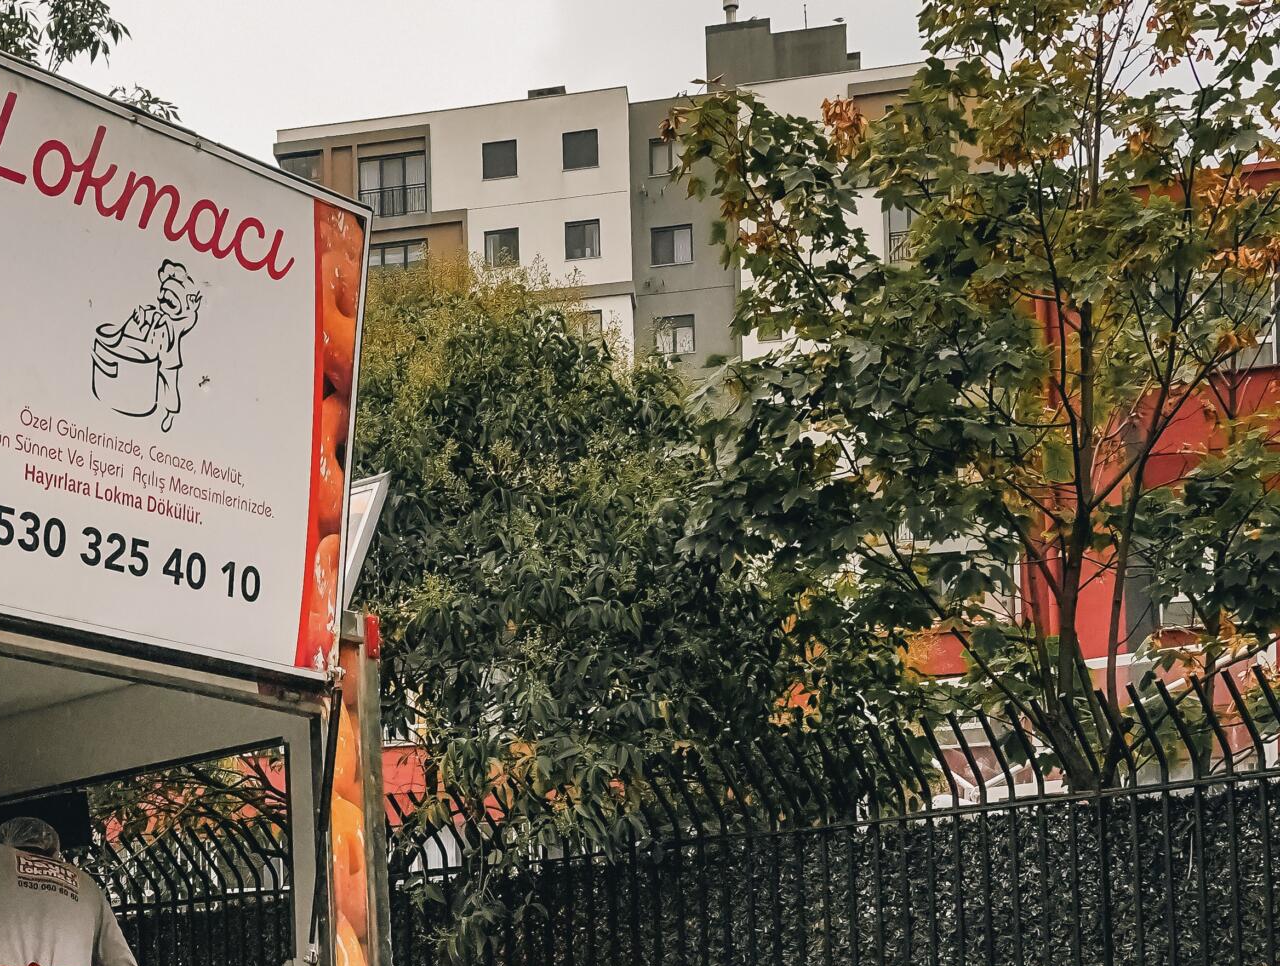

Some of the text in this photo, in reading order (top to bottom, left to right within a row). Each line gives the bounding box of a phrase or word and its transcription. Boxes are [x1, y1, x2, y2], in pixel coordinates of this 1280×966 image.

[15, 434, 62, 462] Sünnet
[67, 448, 84, 469] Ve
[89, 450, 124, 479] İşyeri
[132, 466, 165, 493] Açılış
[169, 478, 275, 519] Merasimlerinizde.
[20, 406, 245, 487] Özel Günlerinizde, Cenaze, Mevlüt,
[24, 463, 203, 525] Hayırlara Lokma Dökülür.
[80, 526, 150, 577] 325
[162, 548, 207, 590] 40
[221, 561, 261, 602] 10
